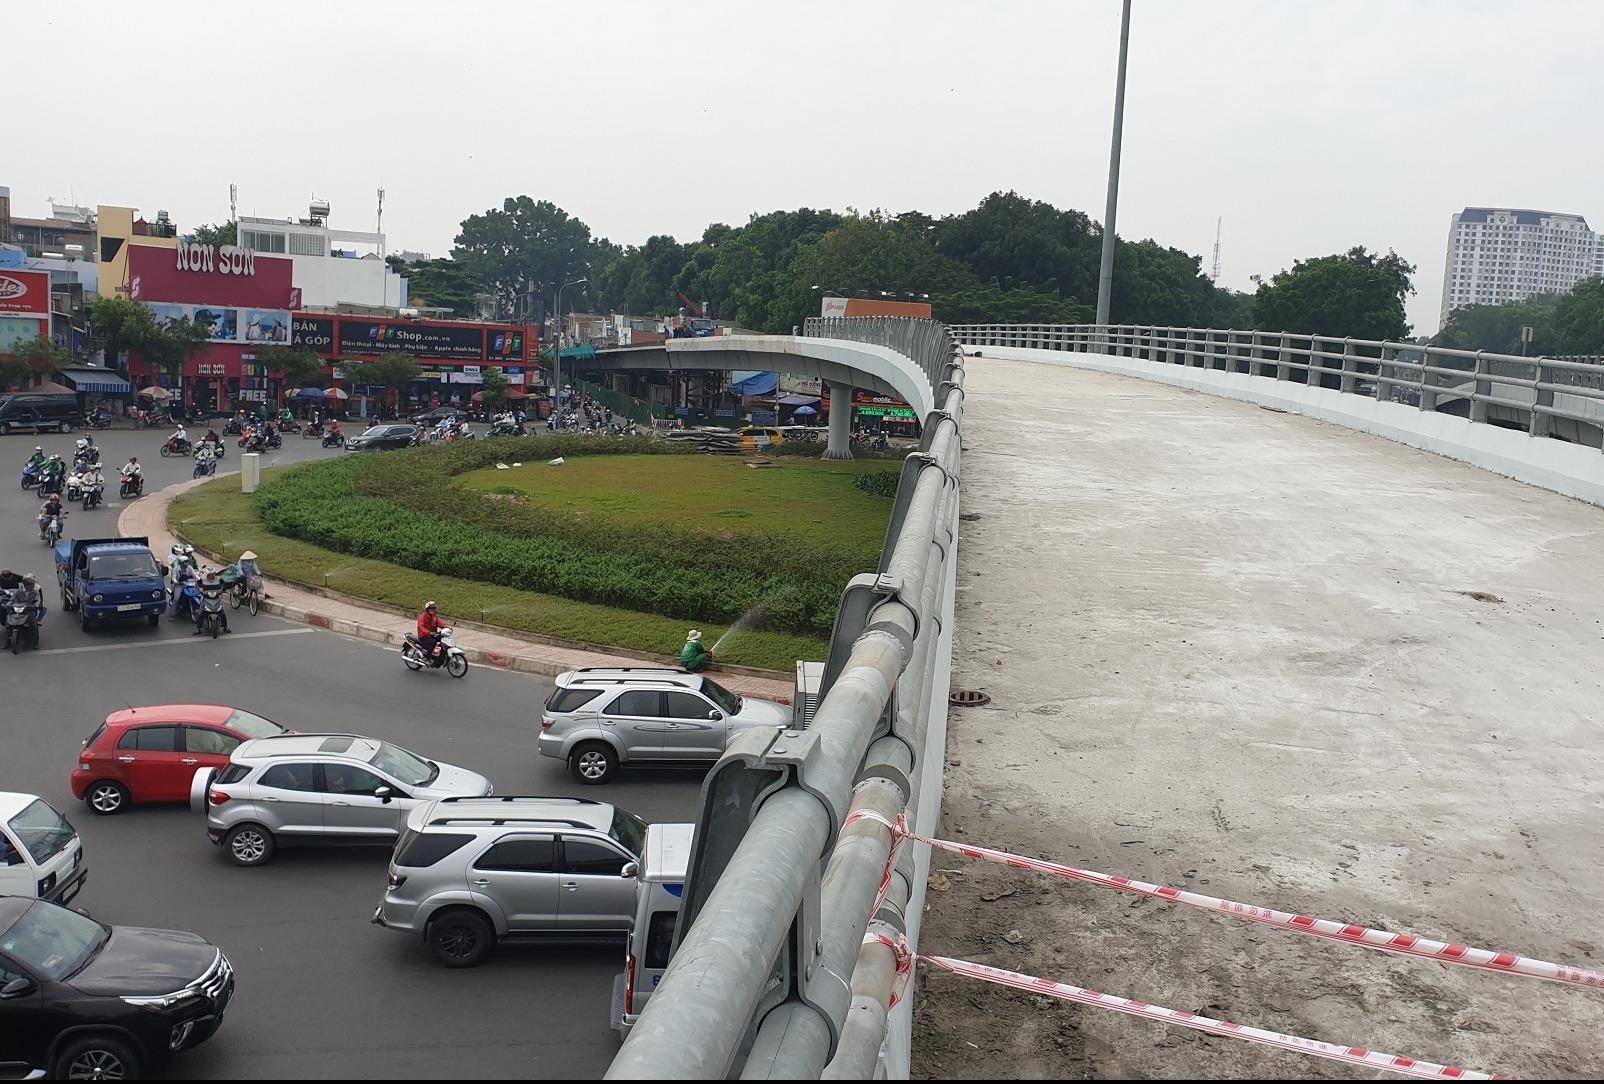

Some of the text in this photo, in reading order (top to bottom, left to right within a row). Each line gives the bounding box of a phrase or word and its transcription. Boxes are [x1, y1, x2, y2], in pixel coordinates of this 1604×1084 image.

[292, 321, 317, 331] BÁN
[291, 332, 330, 345] Ả GÓP
[369, 326, 395, 339] FPT
[239, 389, 267, 401] FREE
